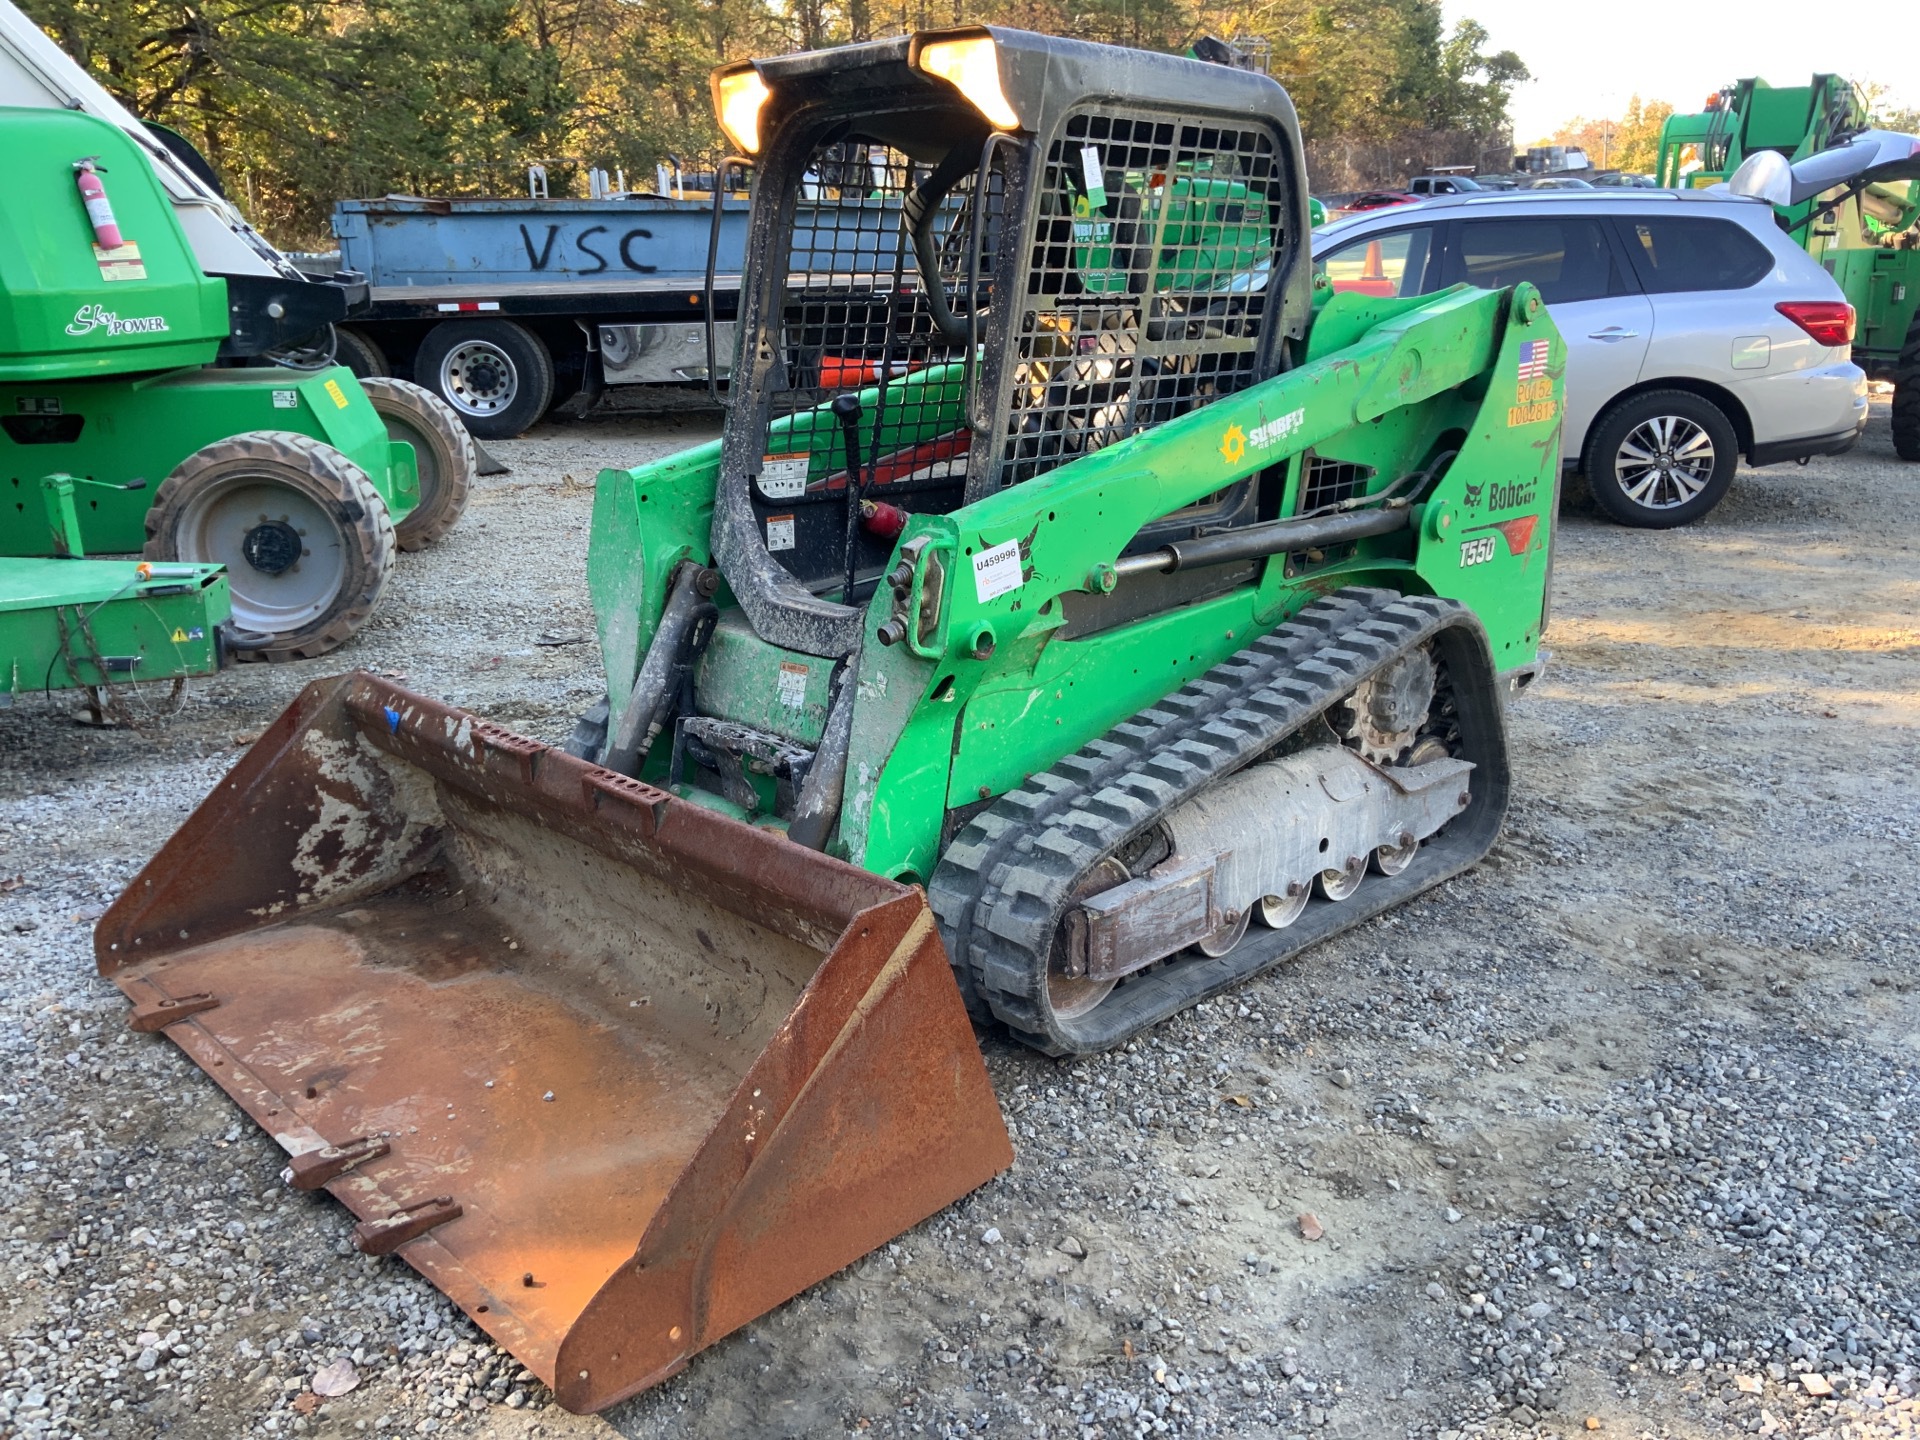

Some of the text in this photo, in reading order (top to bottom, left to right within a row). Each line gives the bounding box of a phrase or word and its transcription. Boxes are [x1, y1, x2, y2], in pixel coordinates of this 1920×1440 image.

[519, 223, 657, 275] VSC
[1258, 427, 1299, 450] RENTAS
[976, 548, 1016, 571] U459996
[1460, 536, 1496, 569] T550
